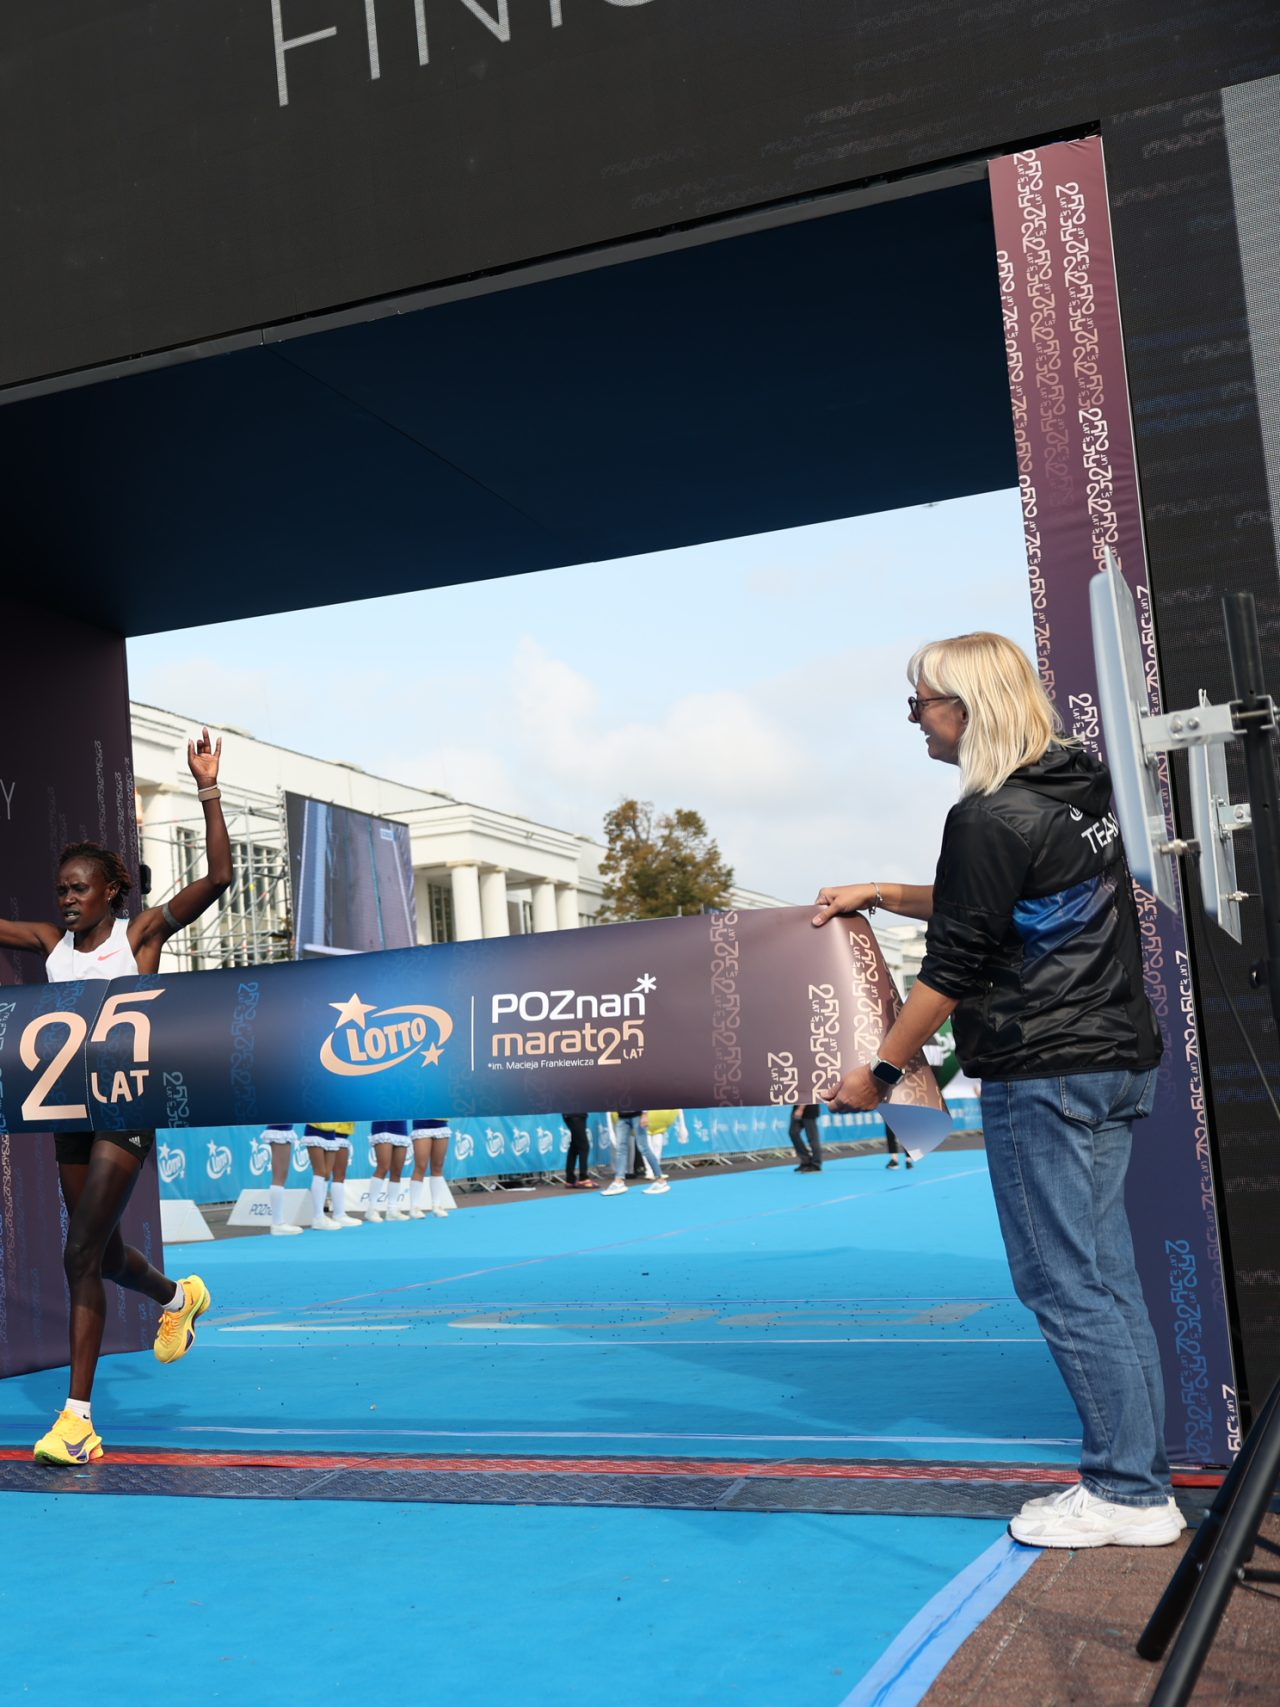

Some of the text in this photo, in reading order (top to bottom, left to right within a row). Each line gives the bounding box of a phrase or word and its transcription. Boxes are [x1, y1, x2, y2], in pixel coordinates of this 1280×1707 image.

[20, 989, 166, 1121] 25
[346, 1017, 426, 1061] LOTTO
[623, 1047, 645, 1060] LAT
[506, 1060, 539, 1070] Macieja
[540, 1058, 594, 1068] Frankiewicza
[91, 1069, 150, 1104] LAT
